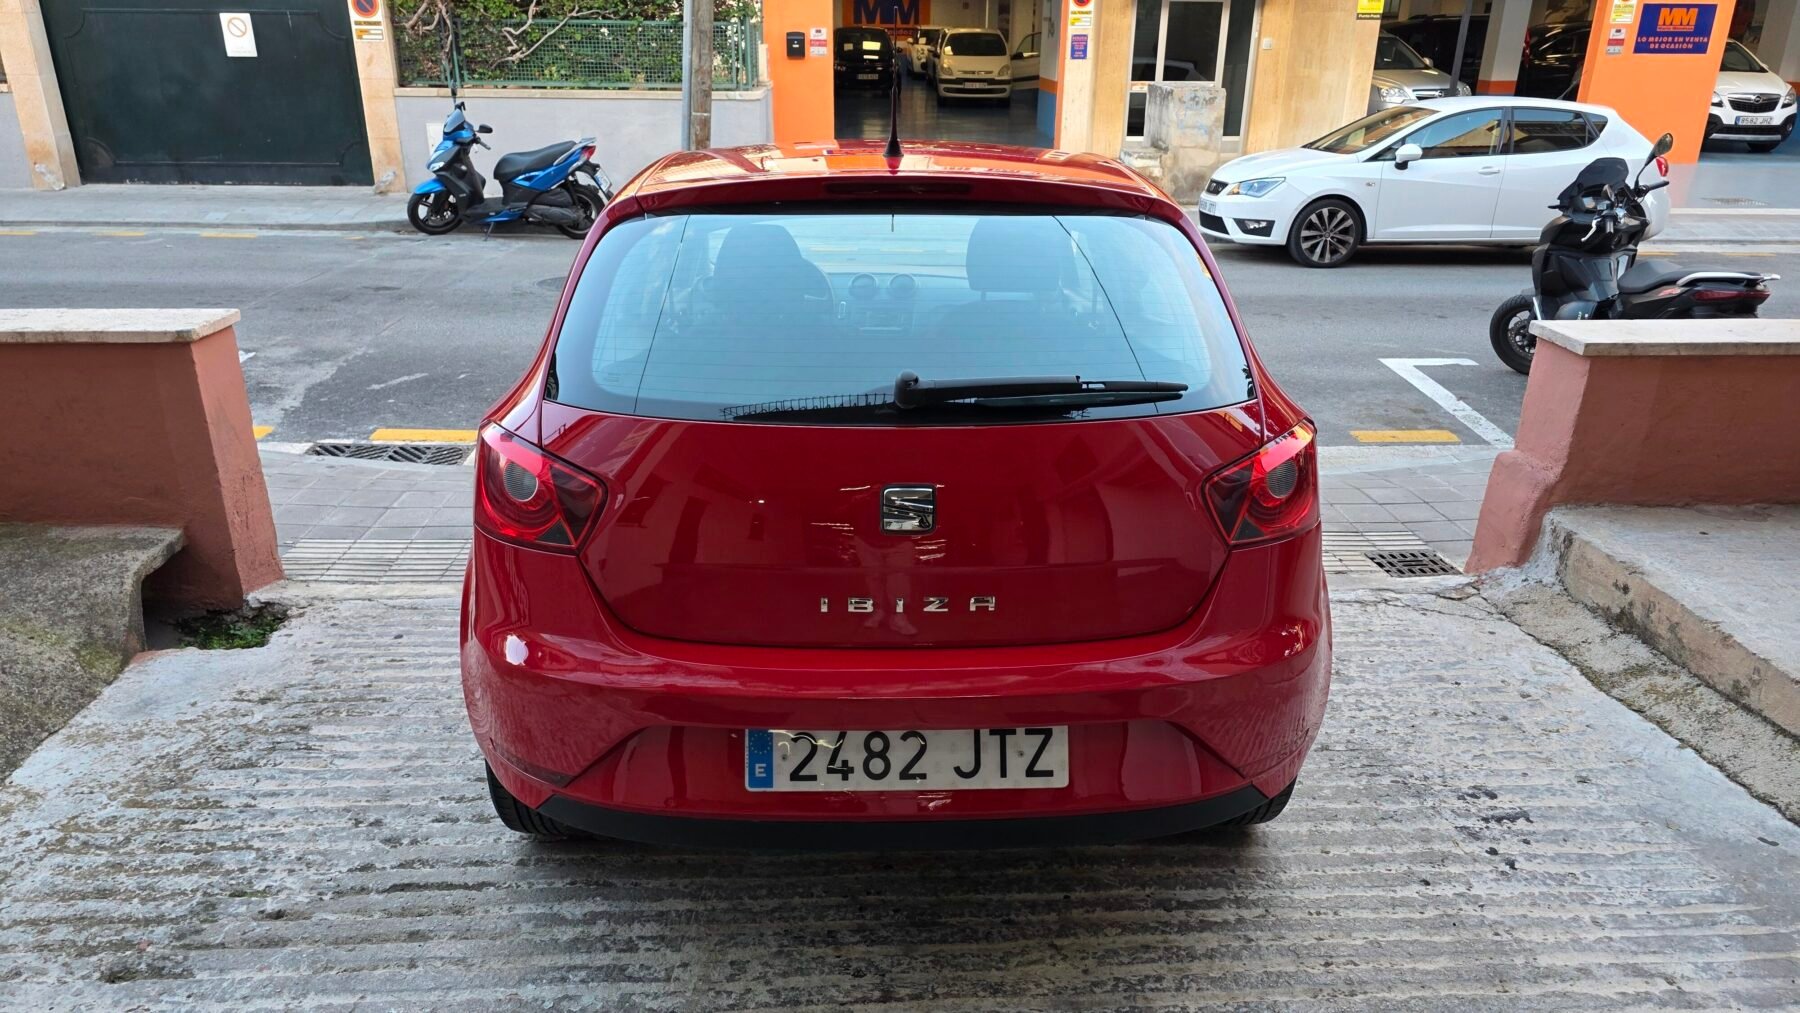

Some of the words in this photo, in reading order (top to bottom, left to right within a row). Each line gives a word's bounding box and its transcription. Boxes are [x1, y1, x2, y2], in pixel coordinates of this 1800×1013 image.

[853, 0, 920, 25] MM
[1658, 8, 1698, 26] MM
[820, 596, 996, 613] IBIZA
[755, 764, 767, 777] E
[789, 730, 928, 782] 2482
[953, 728, 1054, 779] JTZ
